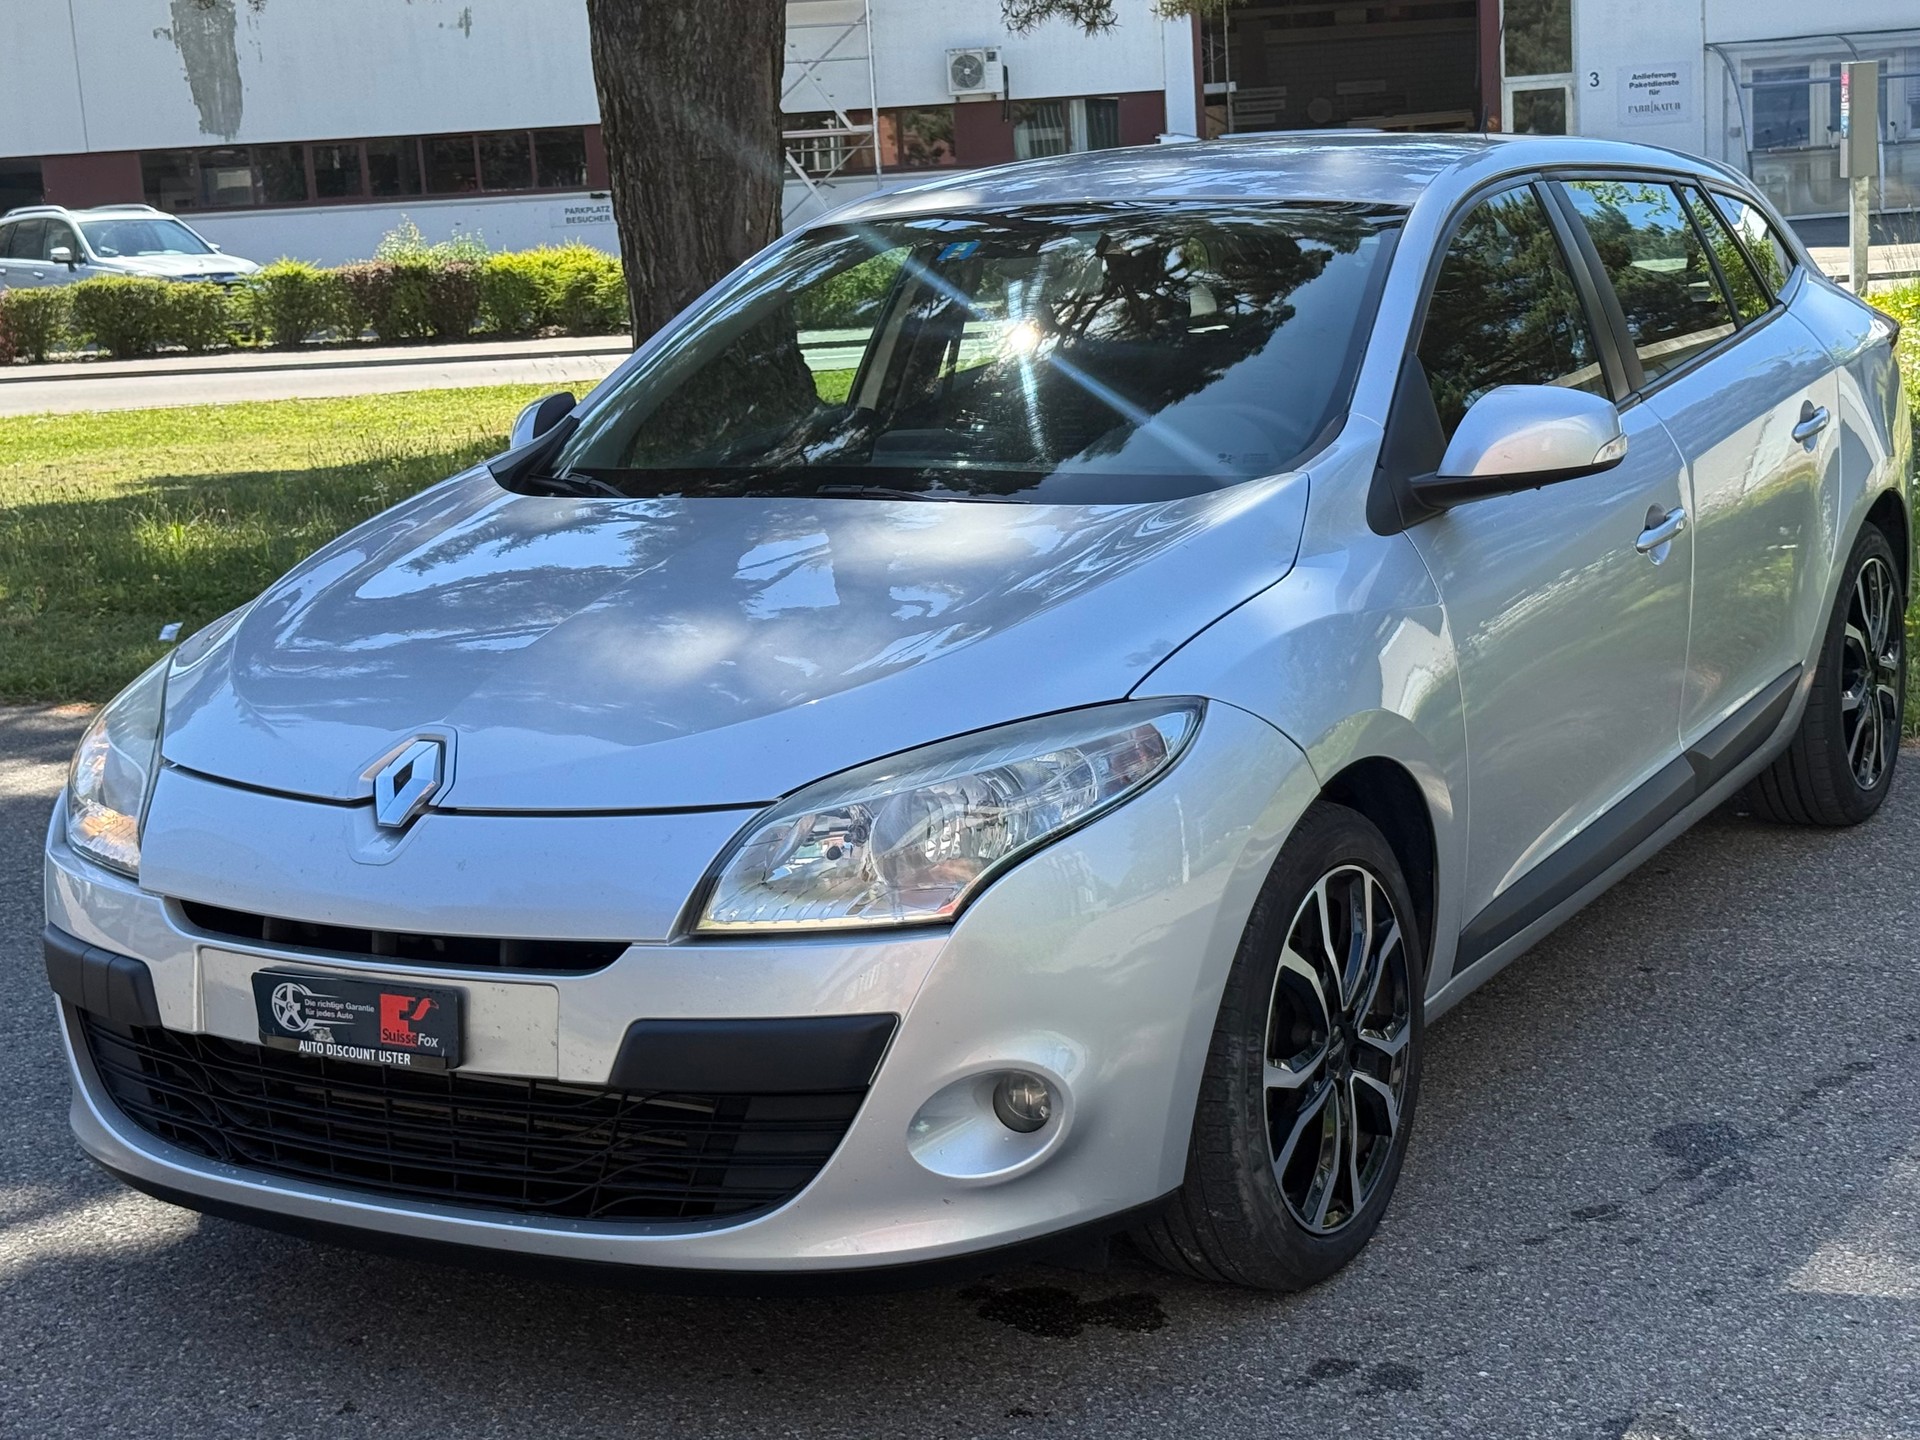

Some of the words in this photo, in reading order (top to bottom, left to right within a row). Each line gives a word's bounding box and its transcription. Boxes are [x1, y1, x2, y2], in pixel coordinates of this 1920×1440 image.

[1589, 71, 1600, 87] 3
[1631, 72, 1677, 80] Anlieferung
[1628, 80, 1680, 89] Paketdienste
[564, 205, 610, 215] PARKPLATZ
[566, 214, 610, 224] BESUCHER
[304, 998, 316, 1007] Die
[317, 1000, 344, 1010] richtige
[345, 1002, 375, 1012] Garantie
[316, 1009, 335, 1017] jedes
[336, 1011, 354, 1019] Auto
[299, 1040, 324, 1054] AUTO
[326, 1043, 375, 1061] DISCOUNT
[378, 1050, 411, 1065] USTER
